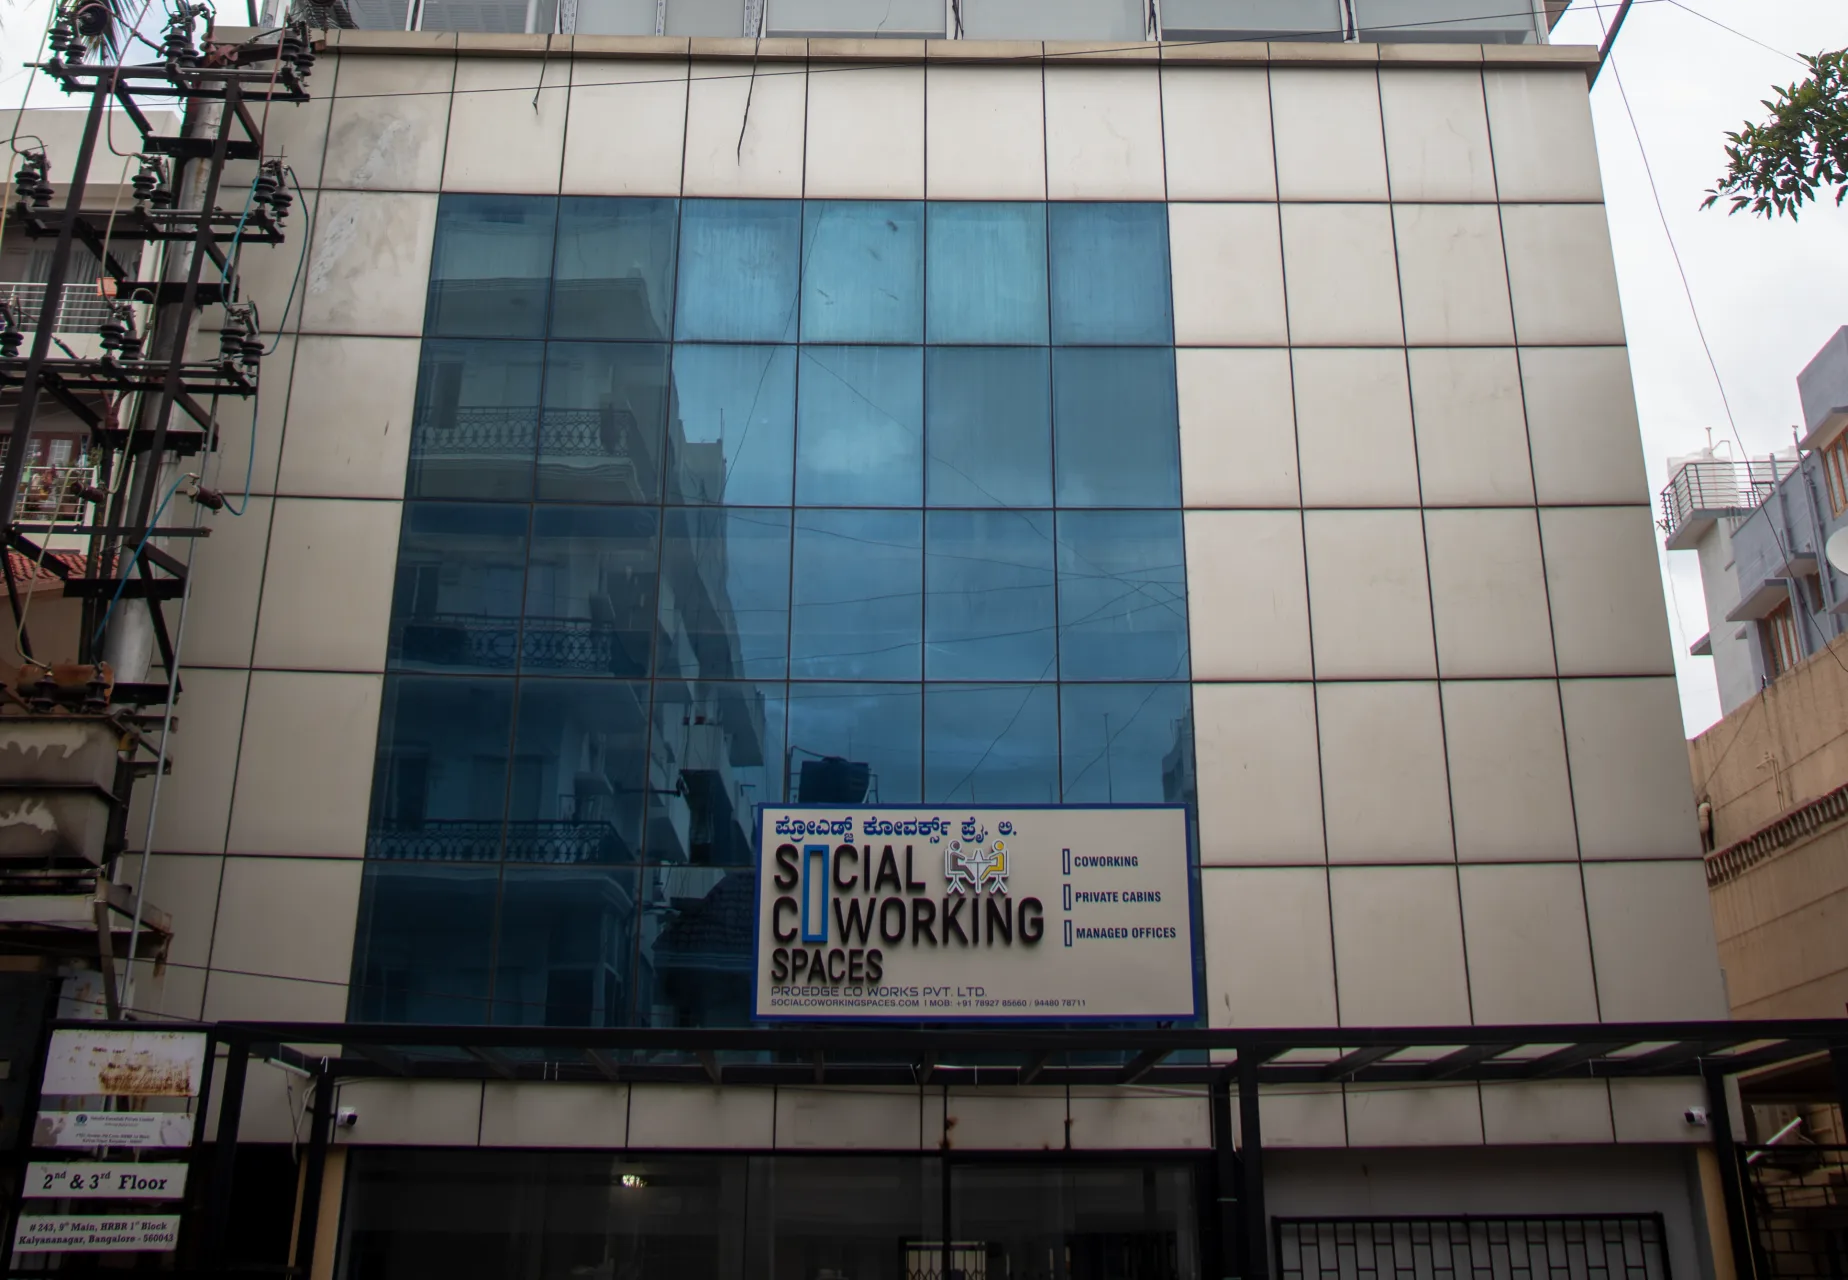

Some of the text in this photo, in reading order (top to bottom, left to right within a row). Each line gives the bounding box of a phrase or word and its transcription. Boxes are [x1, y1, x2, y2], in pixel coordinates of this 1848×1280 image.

[773, 844, 926, 892] SOCIAL
[1074, 855, 1139, 868] COWORKING
[1075, 891, 1162, 903] PRIVATE CABINS
[772, 896, 1045, 945] COWORKING
[1076, 926, 1177, 939] MANAGED OFFICES
[771, 948, 883, 983] SPACES
[771, 986, 988, 998] PROEDGE CO WORKS PVT. LTD.
[771, 999, 920, 1007] SOCIALCOWORKINGSPACES.COM
[929, 999, 952, 1007] MOB:
[956, 999, 972, 1007] +91
[975, 999, 999, 1007] 78927
[1034, 999, 1059, 1007] 94480
[1062, 999, 1086, 1007] 78711
[42, 1171, 168, 1190] 2nd & 3rd Floor
[70, 1222, 98, 1233] Main,
[100, 1222, 128, 1232] HRBR
[141, 1221, 168, 1231] Block
[88, 1234, 136, 1246] Bangalore
